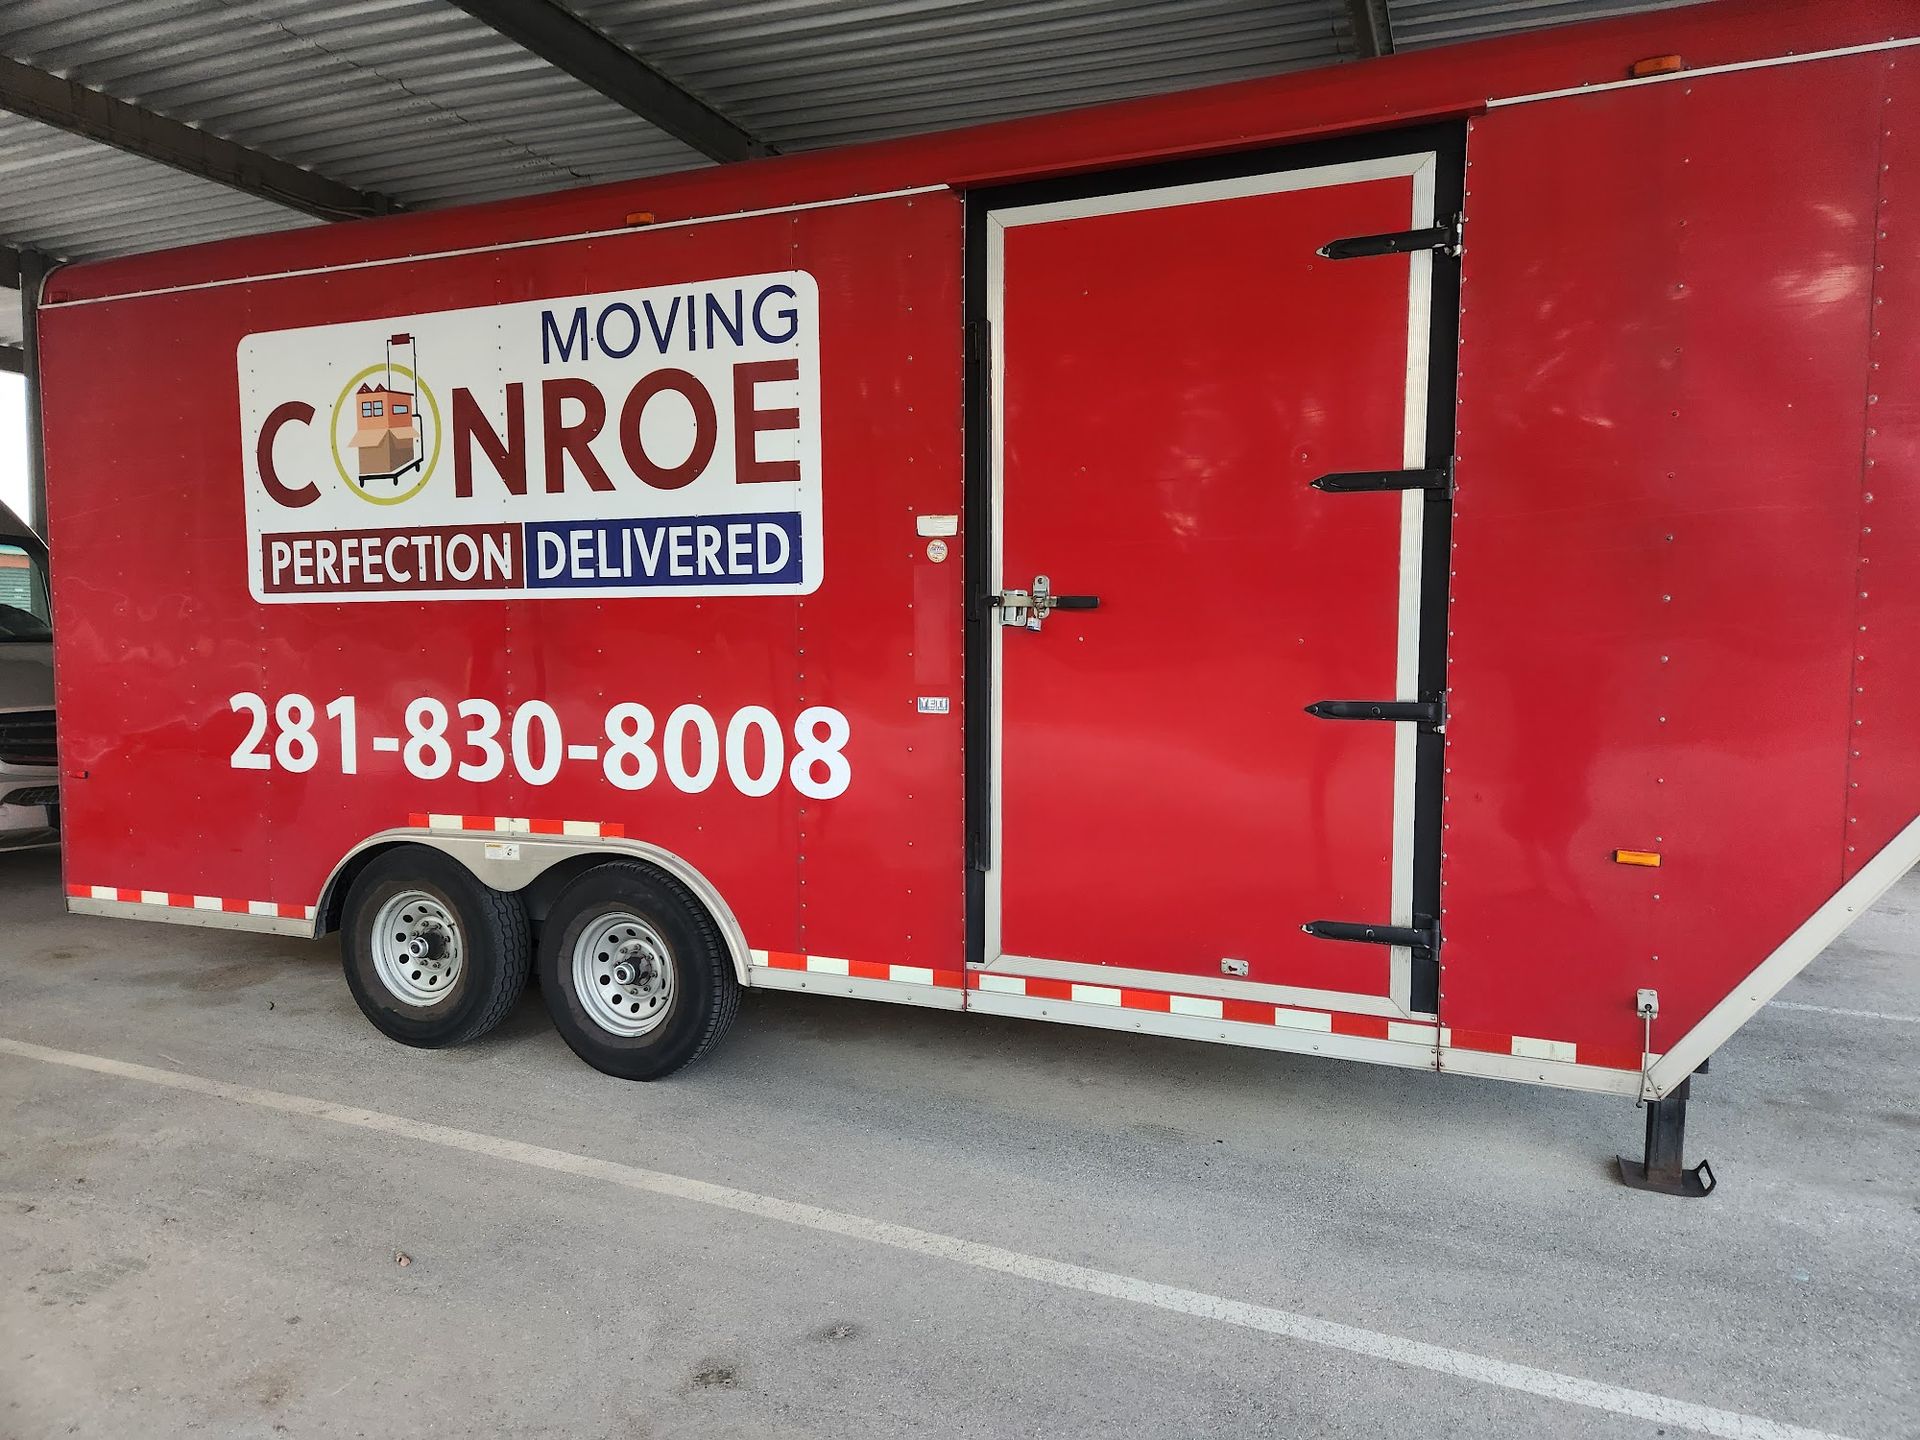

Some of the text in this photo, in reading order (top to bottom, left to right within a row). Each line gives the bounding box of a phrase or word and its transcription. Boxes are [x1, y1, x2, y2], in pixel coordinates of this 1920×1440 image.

[542, 284, 799, 364] MOVING
[271, 522, 791, 586] PERFECTION DELIVERED
[228, 692, 852, 800] 281-830-8008
